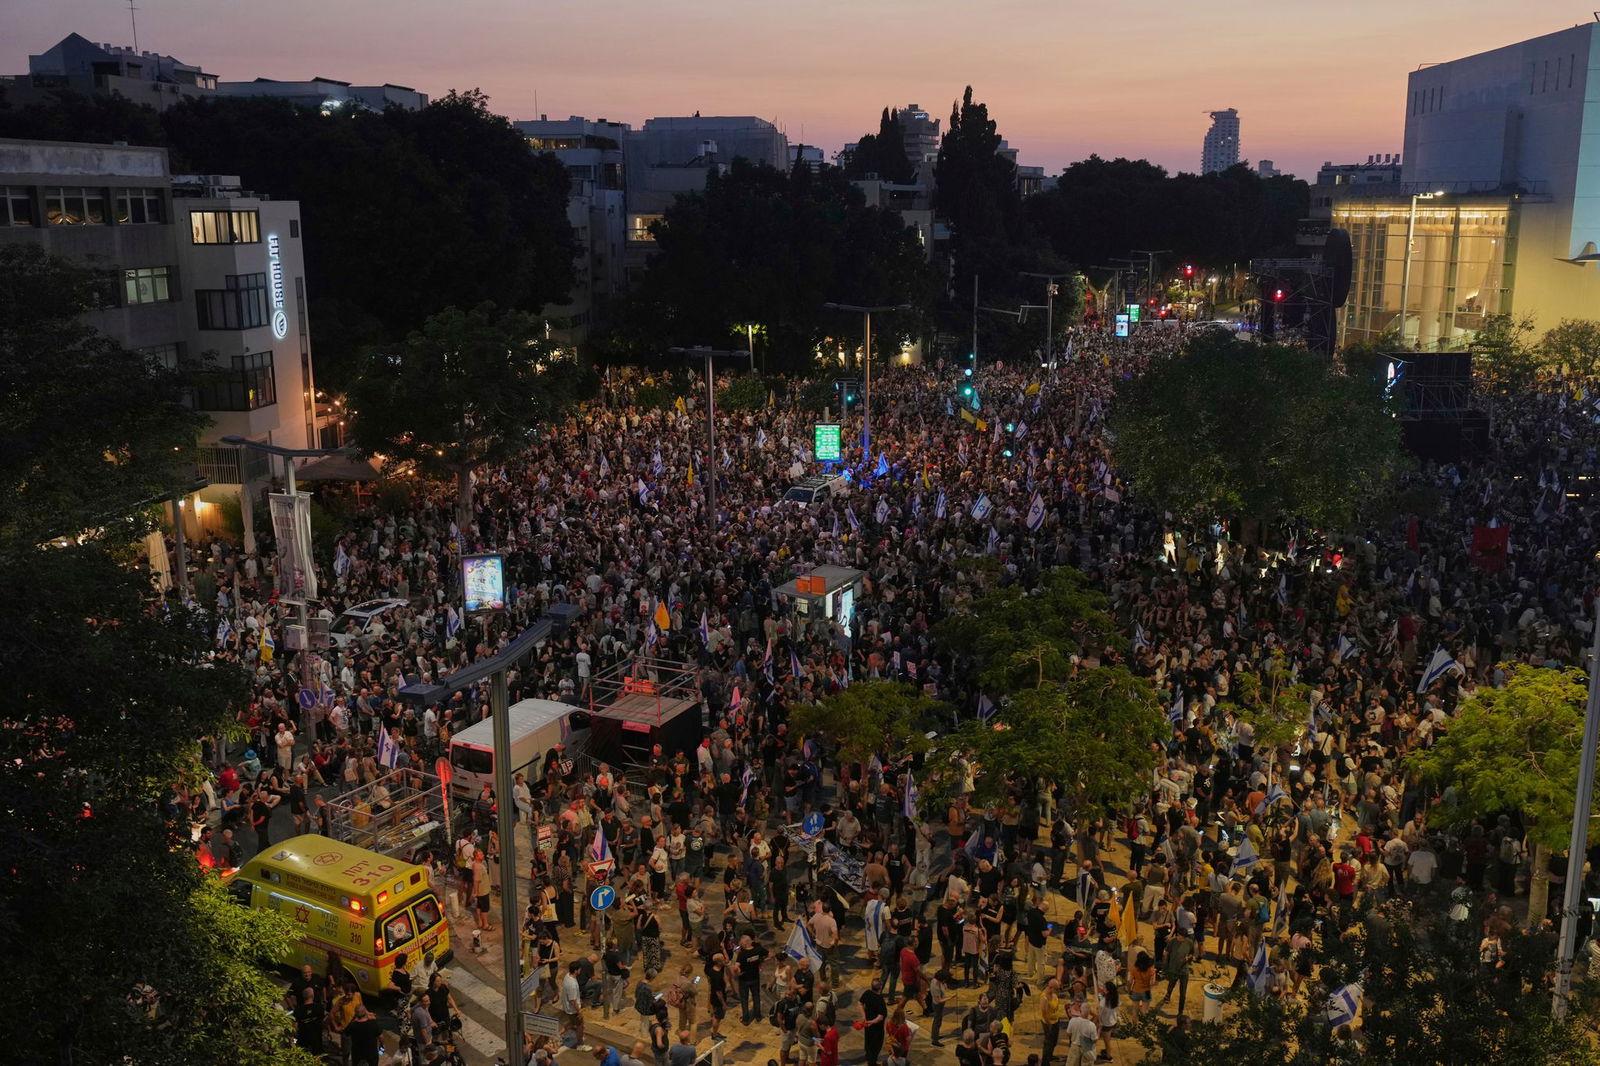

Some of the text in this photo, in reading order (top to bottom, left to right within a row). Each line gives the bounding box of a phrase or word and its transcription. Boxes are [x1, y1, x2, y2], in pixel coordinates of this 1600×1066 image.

[270, 237, 285, 308] FIT HOUSE
[352, 865, 394, 887] 310
[350, 932, 362, 945] 310
